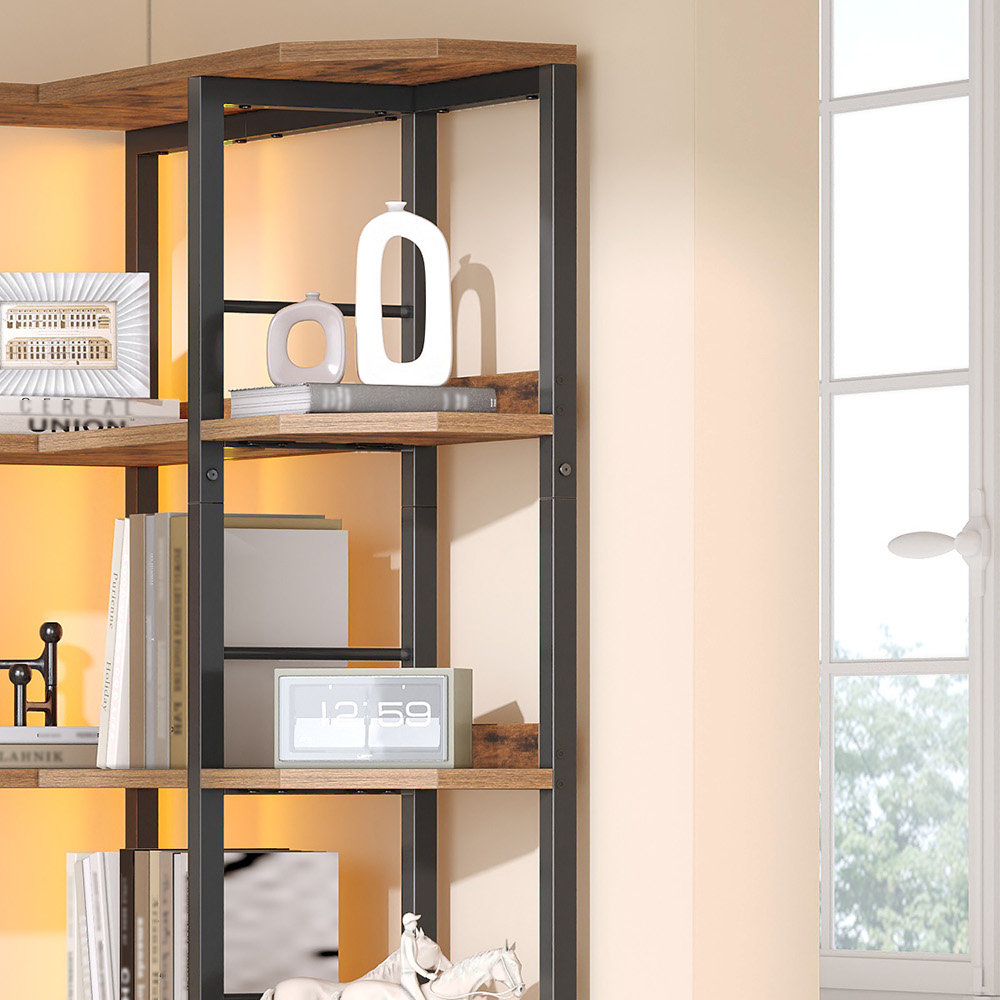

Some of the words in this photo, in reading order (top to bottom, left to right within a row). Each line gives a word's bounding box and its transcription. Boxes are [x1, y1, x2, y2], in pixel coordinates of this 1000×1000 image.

[19, 397, 132, 416] CEREAL
[27, 418, 126, 433] UNION
[101, 661, 112, 712] Holiday
